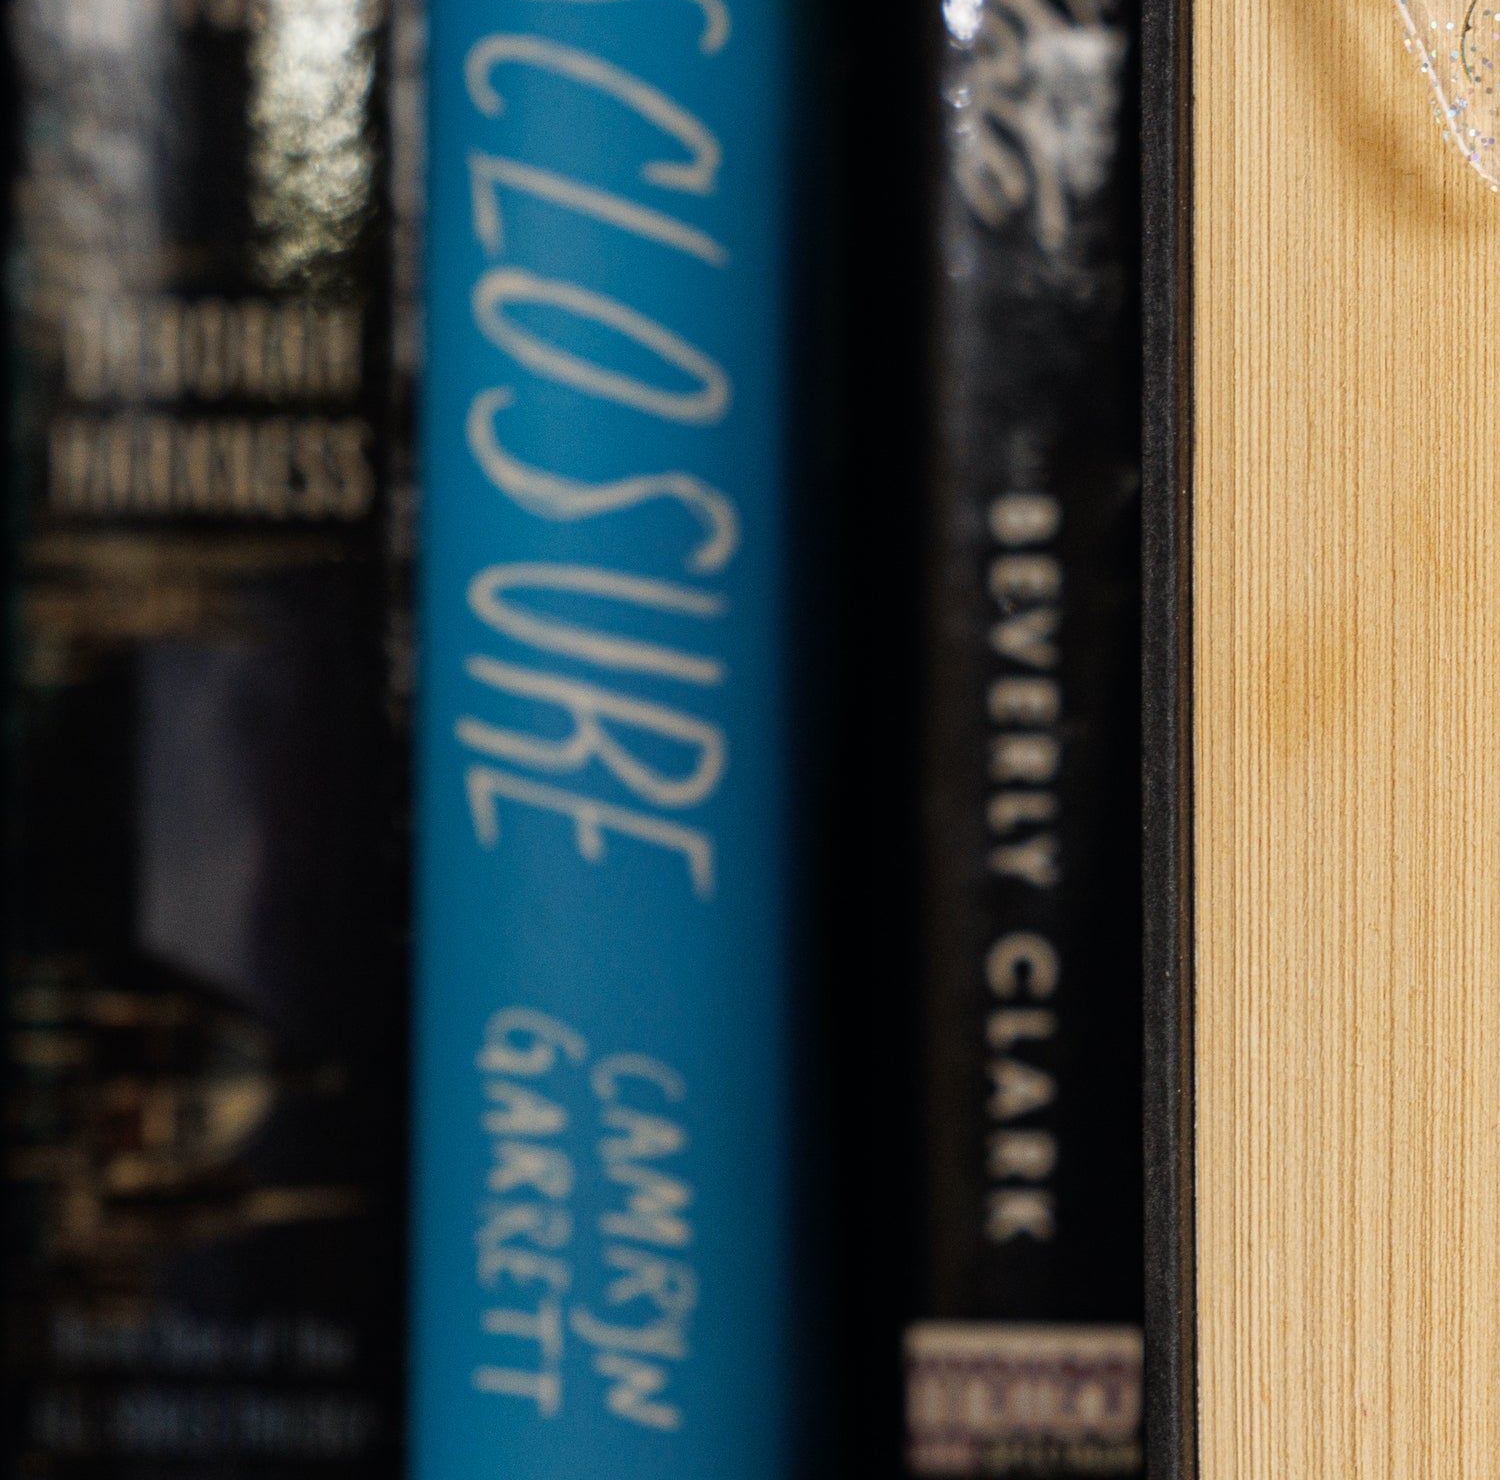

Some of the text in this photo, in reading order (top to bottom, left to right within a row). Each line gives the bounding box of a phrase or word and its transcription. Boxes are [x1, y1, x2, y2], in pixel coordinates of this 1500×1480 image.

[984, 491, 1064, 1245] BEVERLY CLARK
[471, 1005, 589, 1419] GARRETT
[567, 1051, 699, 1433] CAMRYN
